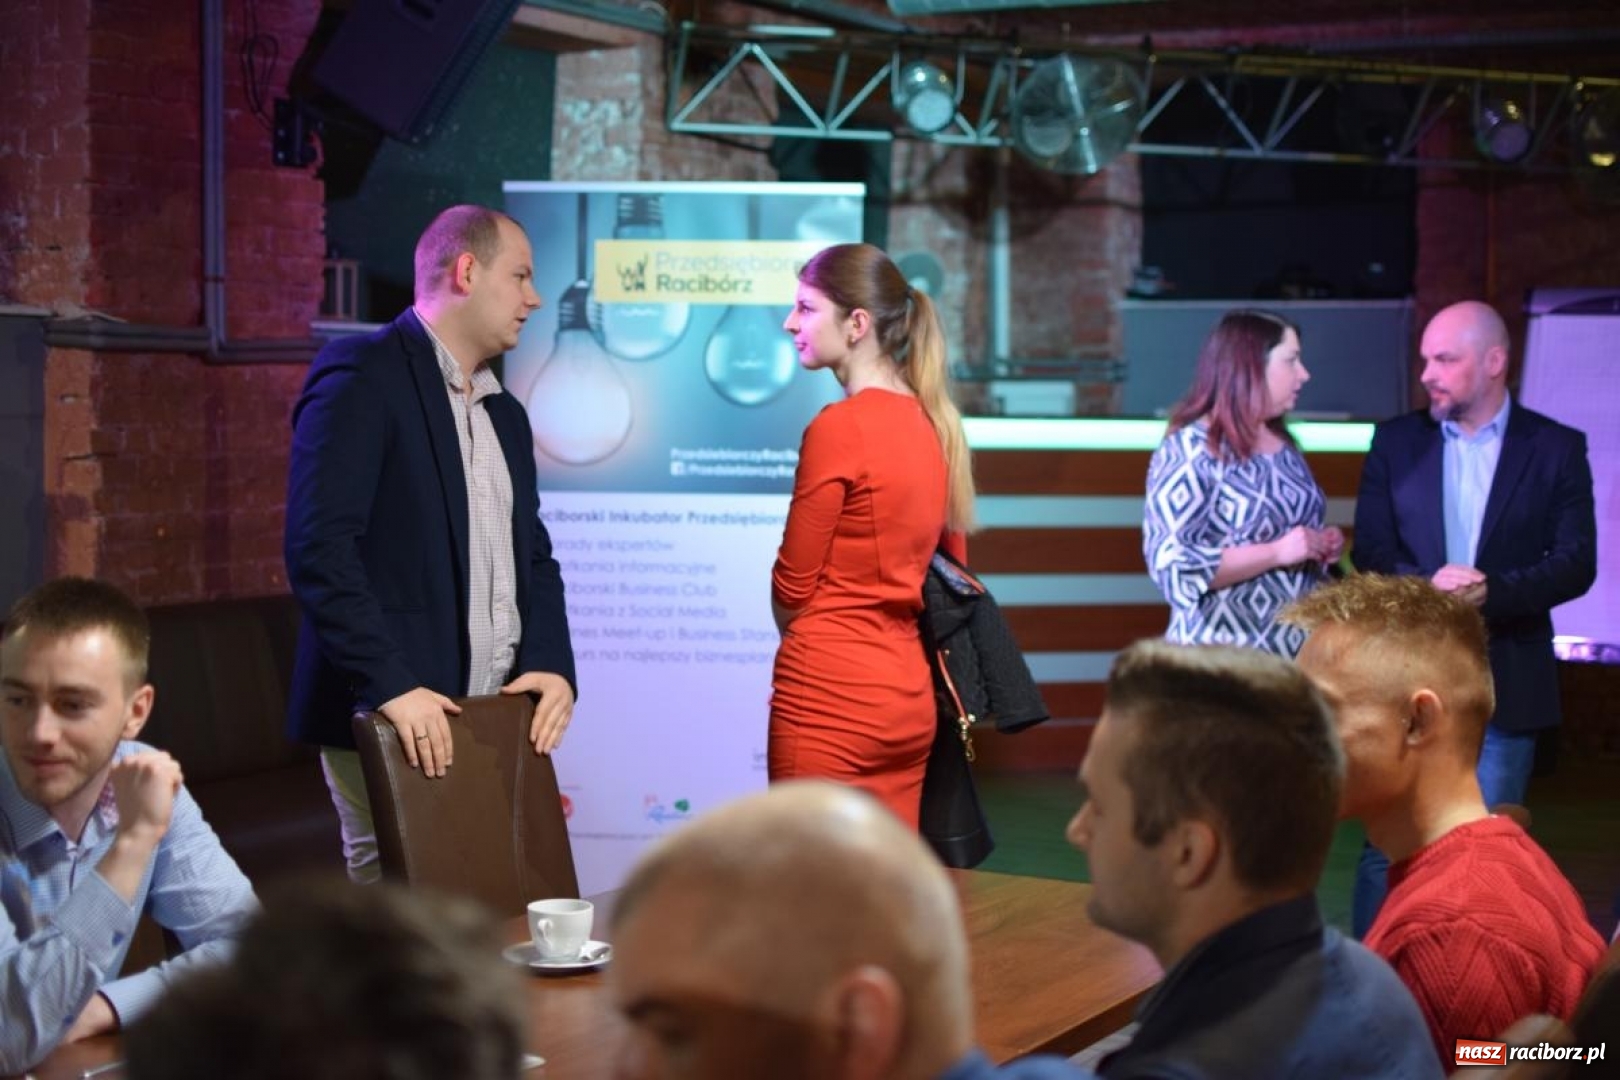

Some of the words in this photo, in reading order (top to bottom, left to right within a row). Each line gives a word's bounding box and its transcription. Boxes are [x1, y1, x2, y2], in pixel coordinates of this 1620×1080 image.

[656, 273, 753, 293] Racibórz
[539, 508, 606, 525] aciborski
[609, 508, 683, 525] Inkubator
[597, 538, 674, 555] ekspertów
[618, 560, 717, 577] informacyjne
[619, 582, 677, 597] Business
[681, 582, 718, 597] Club
[629, 604, 674, 619] Social
[678, 605, 727, 619] Media
[678, 627, 737, 642] Business
[600, 649, 620, 662] na
[623, 647, 690, 665] najlepszy
